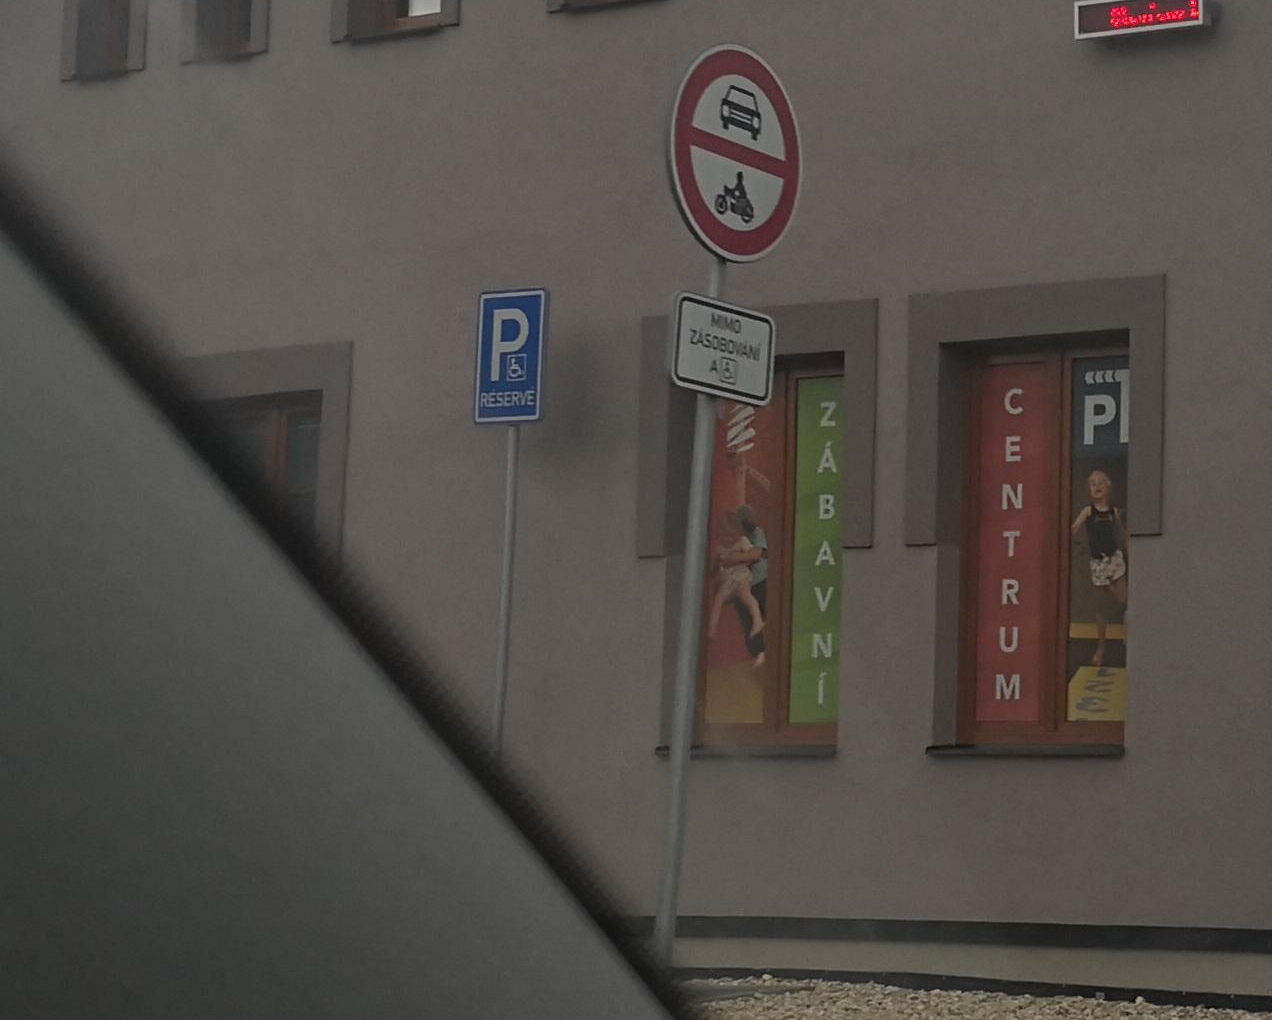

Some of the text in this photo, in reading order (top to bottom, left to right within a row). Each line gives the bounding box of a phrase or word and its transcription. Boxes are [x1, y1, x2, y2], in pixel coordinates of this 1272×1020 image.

[490, 308, 530, 382] P
[710, 312, 742, 334] MIMO
[709, 359, 718, 374] A
[811, 401, 837, 705] ZÁBAVNÍ
[995, 387, 1024, 701] CENTRUM
